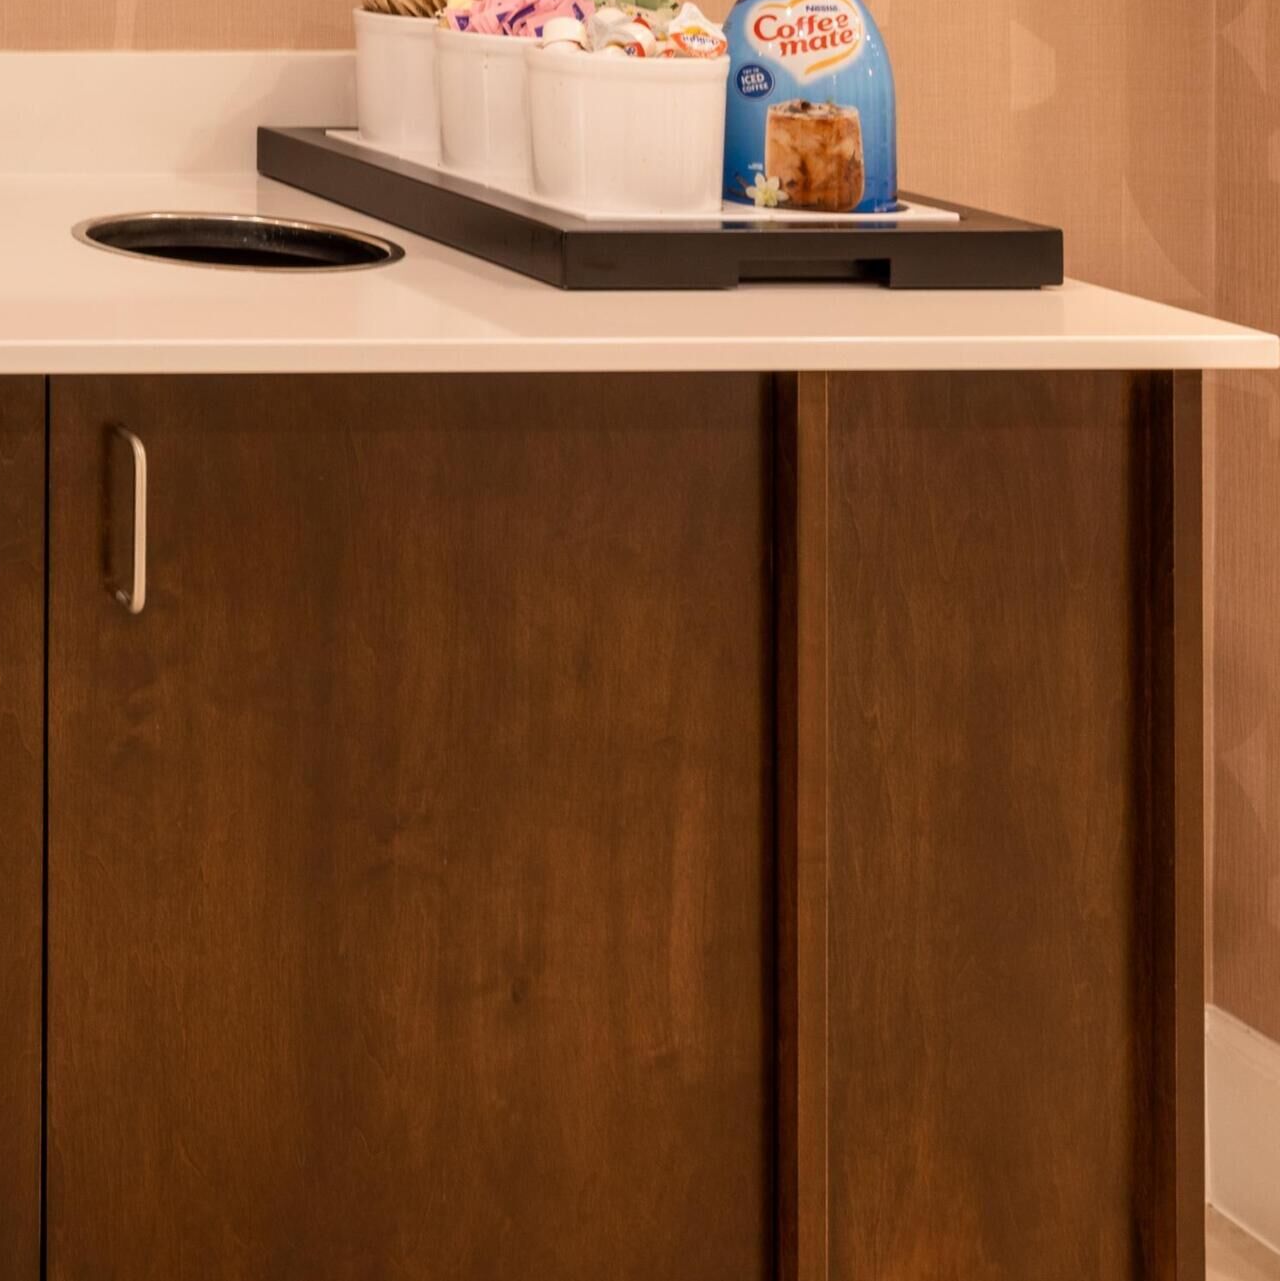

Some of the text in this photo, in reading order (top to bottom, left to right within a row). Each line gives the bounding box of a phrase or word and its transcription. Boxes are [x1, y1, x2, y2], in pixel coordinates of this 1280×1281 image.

[754, 14, 849, 41] Coffee
[780, 29, 854, 57] mate
[741, 72, 765, 86] ICED
